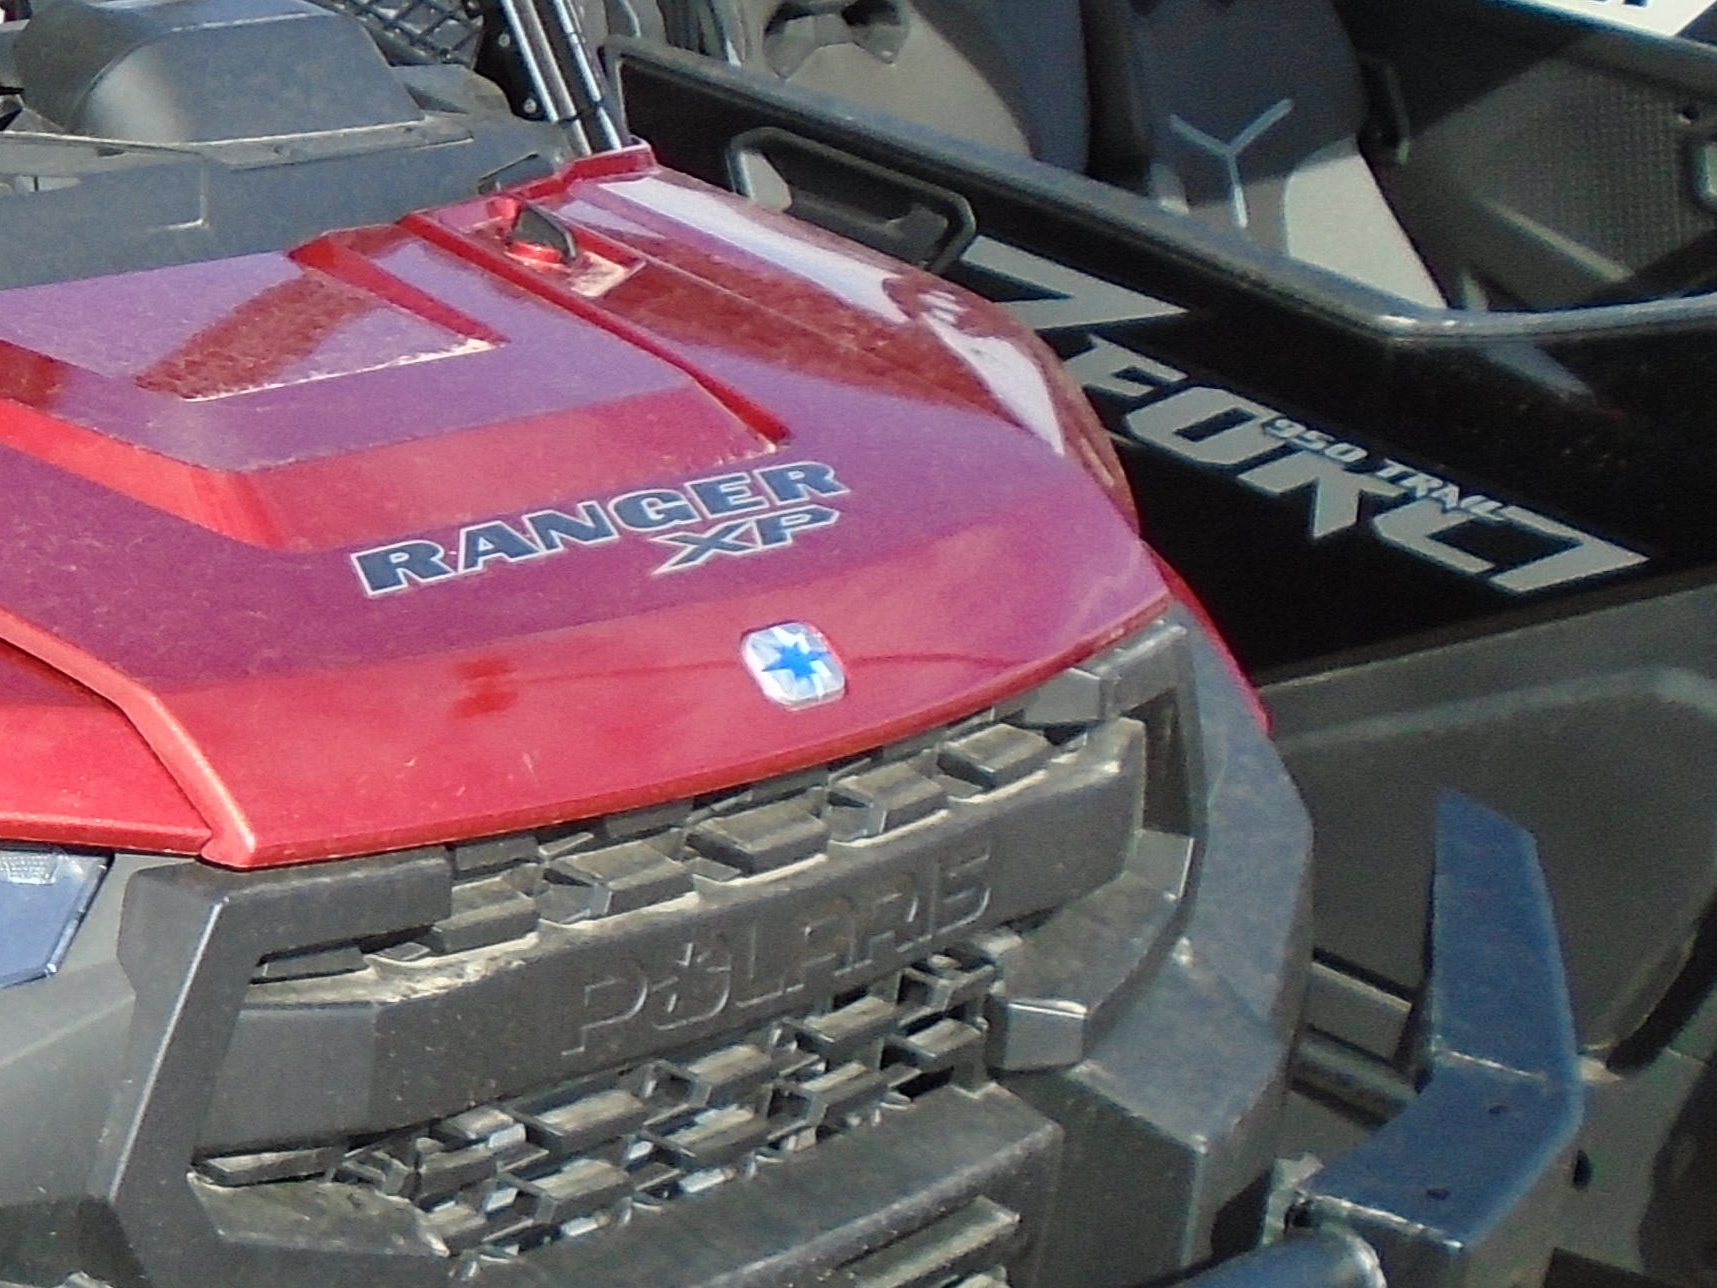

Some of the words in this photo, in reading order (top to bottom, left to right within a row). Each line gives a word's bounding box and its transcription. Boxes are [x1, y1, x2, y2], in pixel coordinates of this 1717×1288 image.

[350, 459, 850, 598] RANGER
[1264, 417, 1368, 463] 950
[1376, 457, 1515, 522] TRAIL
[651, 504, 840, 575] XP
[560, 839, 992, 1057] POLARIS
